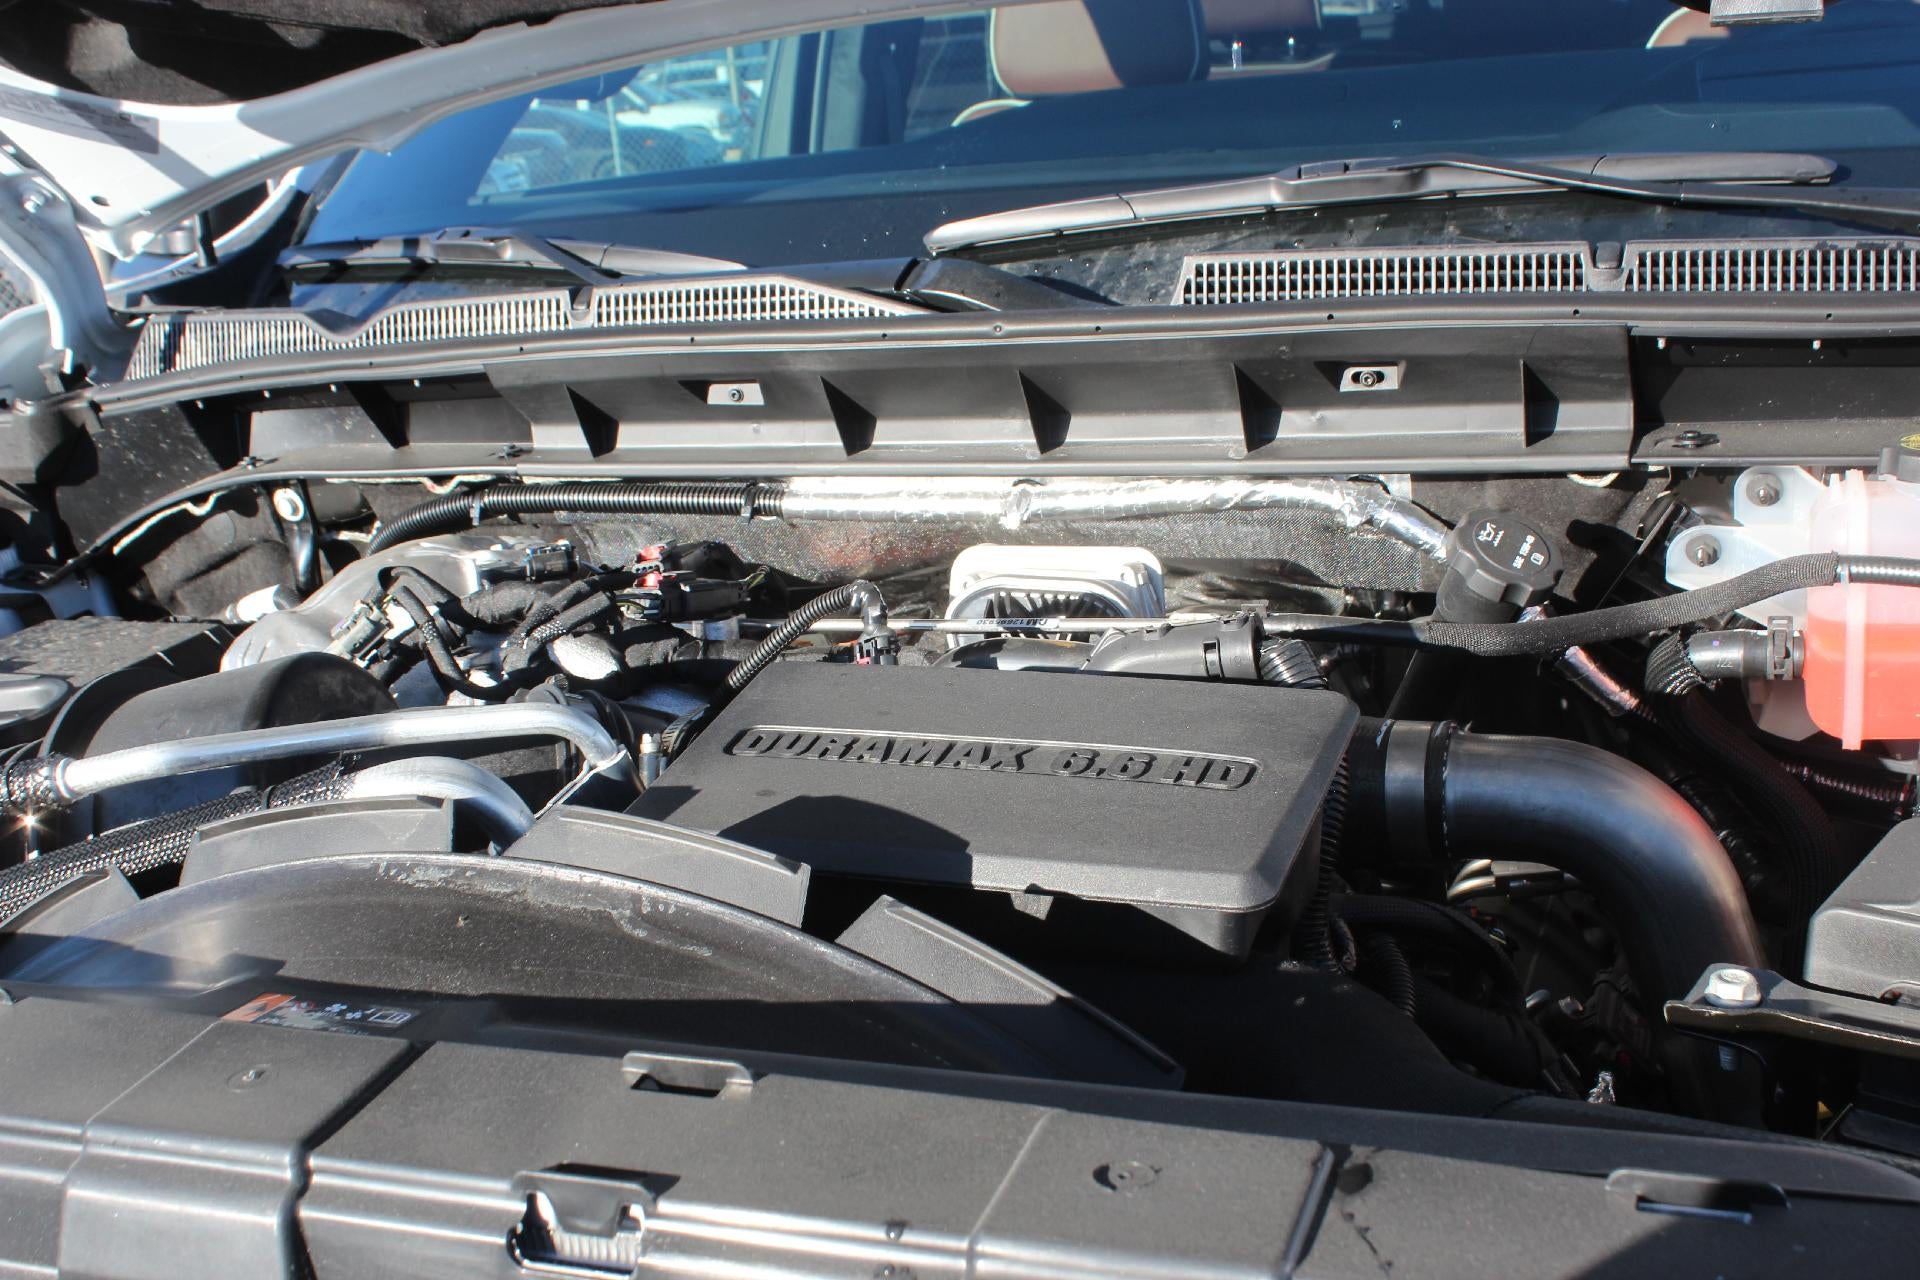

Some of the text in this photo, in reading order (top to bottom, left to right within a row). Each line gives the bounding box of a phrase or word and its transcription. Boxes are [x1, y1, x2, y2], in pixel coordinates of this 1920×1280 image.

[731, 729, 1257, 790] DURAMAX 6.6 HD
